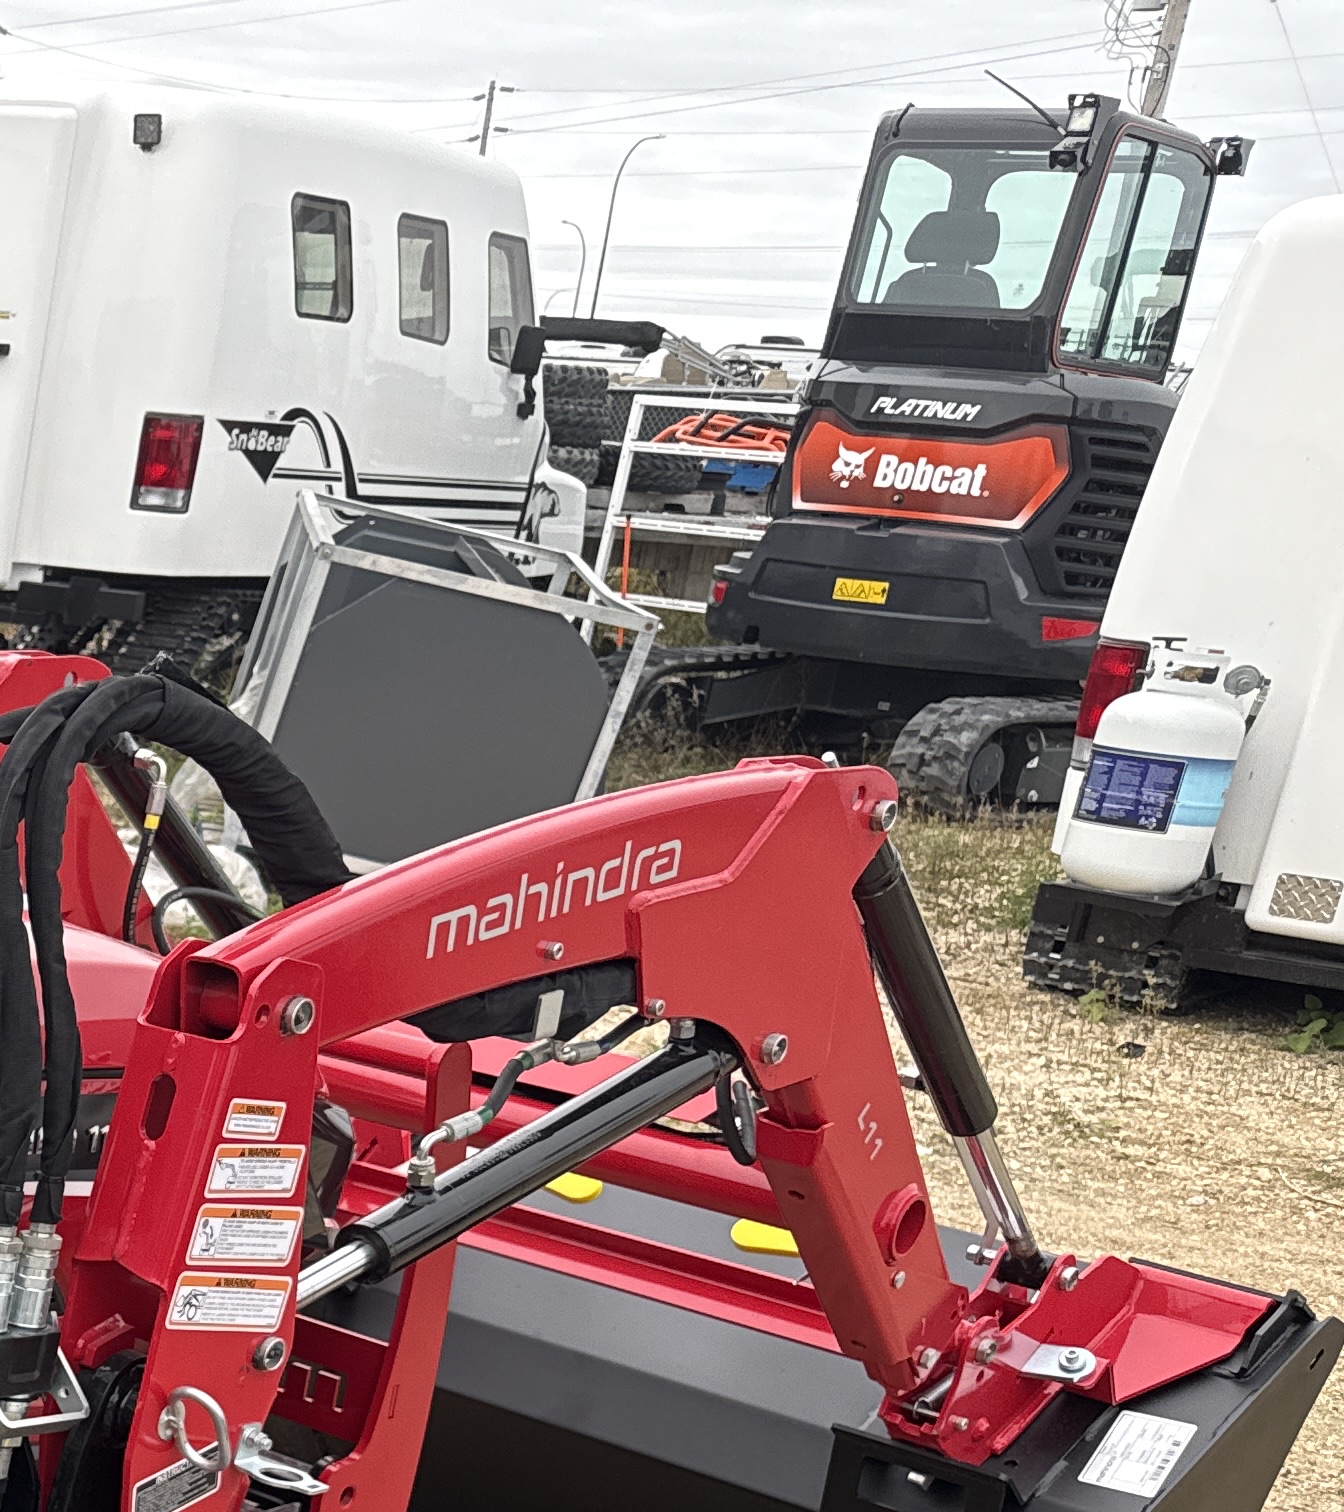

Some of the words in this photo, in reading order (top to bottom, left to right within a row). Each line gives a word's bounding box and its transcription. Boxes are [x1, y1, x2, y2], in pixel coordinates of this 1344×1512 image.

[870, 396, 982, 422] PLATINUM
[873, 453, 989, 497] Bobcat
[425, 839, 682, 960] mahindra
